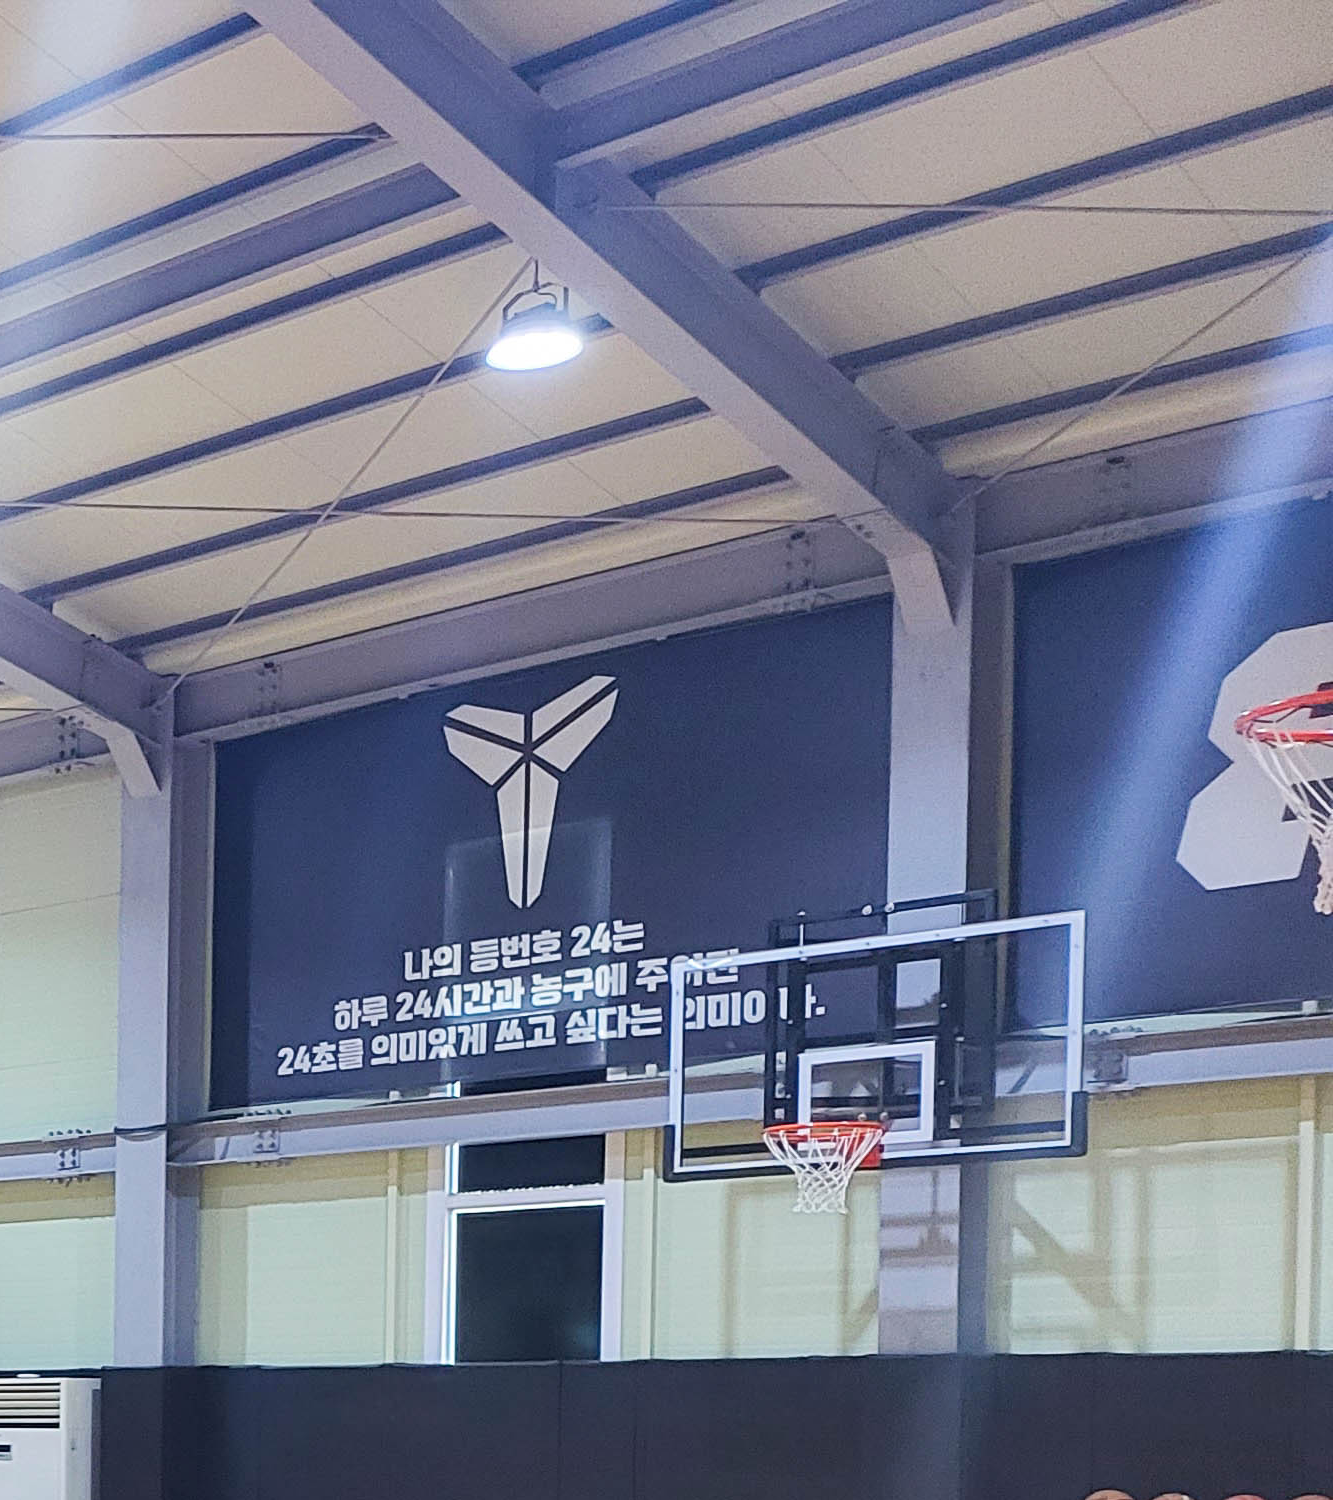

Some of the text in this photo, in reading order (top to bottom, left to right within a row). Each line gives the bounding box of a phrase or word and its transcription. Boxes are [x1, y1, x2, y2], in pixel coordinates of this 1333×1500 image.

[404, 919, 645, 981] 나의 등번호 24는
[334, 995, 389, 1031] 하루
[396, 976, 525, 1022] 24시간과
[530, 962, 627, 1006] 농구에
[277, 1038, 364, 1075] 24초를
[370, 1022, 487, 1067] 의미있게
[494, 1012, 557, 1051] 쓰고
[565, 1003, 663, 1045] 싶다는
